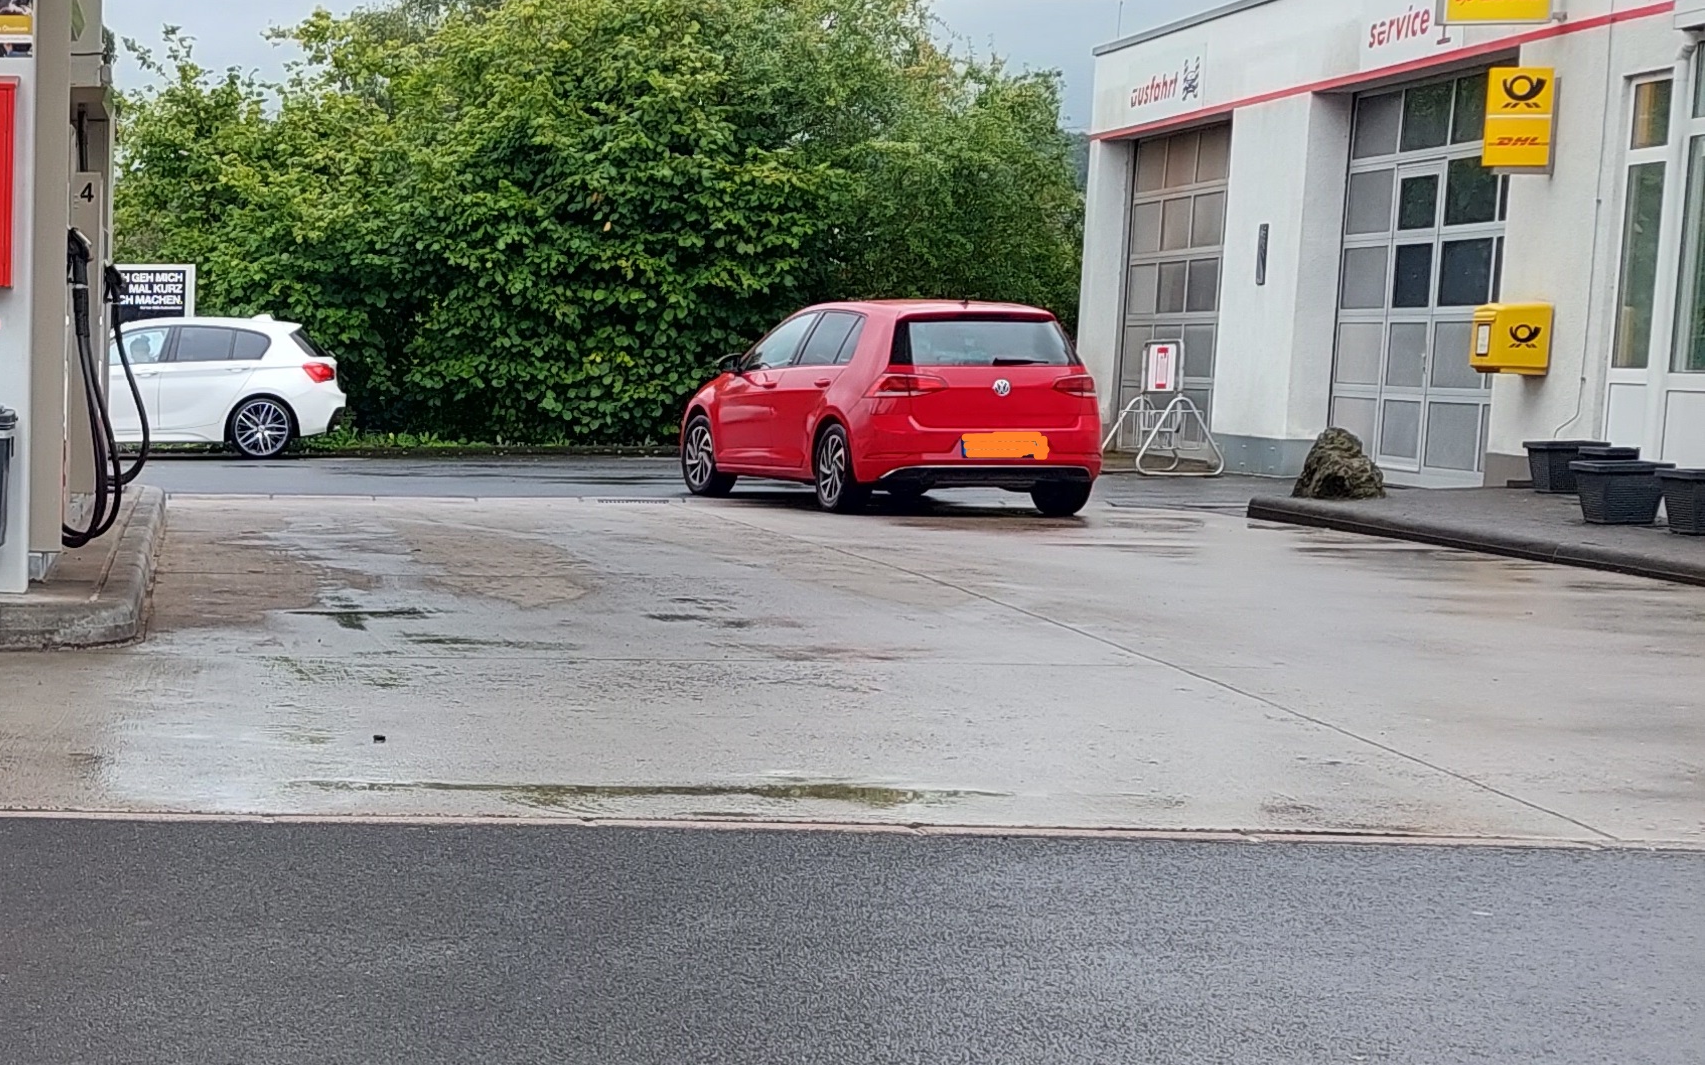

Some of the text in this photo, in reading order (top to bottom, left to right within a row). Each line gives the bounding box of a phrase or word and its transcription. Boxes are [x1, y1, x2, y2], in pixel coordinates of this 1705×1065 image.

[1368, 5, 1431, 49] service
[1496, 136, 1541, 146] DHL
[80, 182, 94, 203] 4
[131, 272, 154, 283] GEH
[155, 272, 183, 283] MICH
[128, 283, 183, 294] MAL KURZ
[134, 295, 183, 305] MACHEN.
